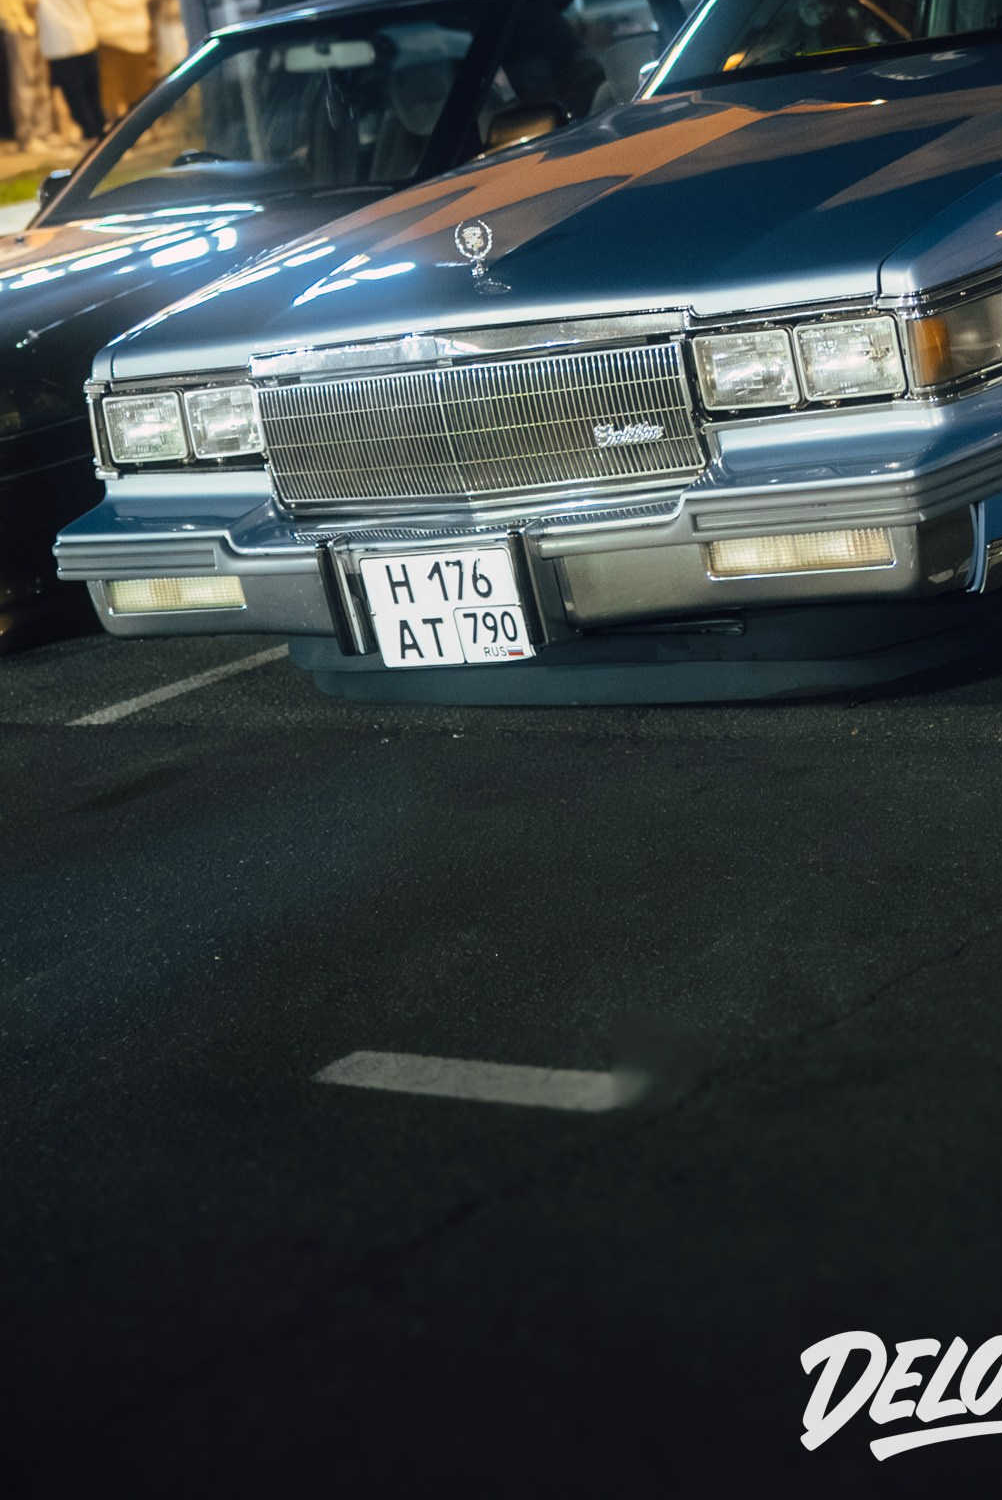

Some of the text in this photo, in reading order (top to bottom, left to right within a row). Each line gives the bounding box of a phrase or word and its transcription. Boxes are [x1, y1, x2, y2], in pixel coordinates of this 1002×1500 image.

[427, 558, 492, 601] 176
[463, 611, 517, 644] 790
[484, 646, 507, 657] RUS
